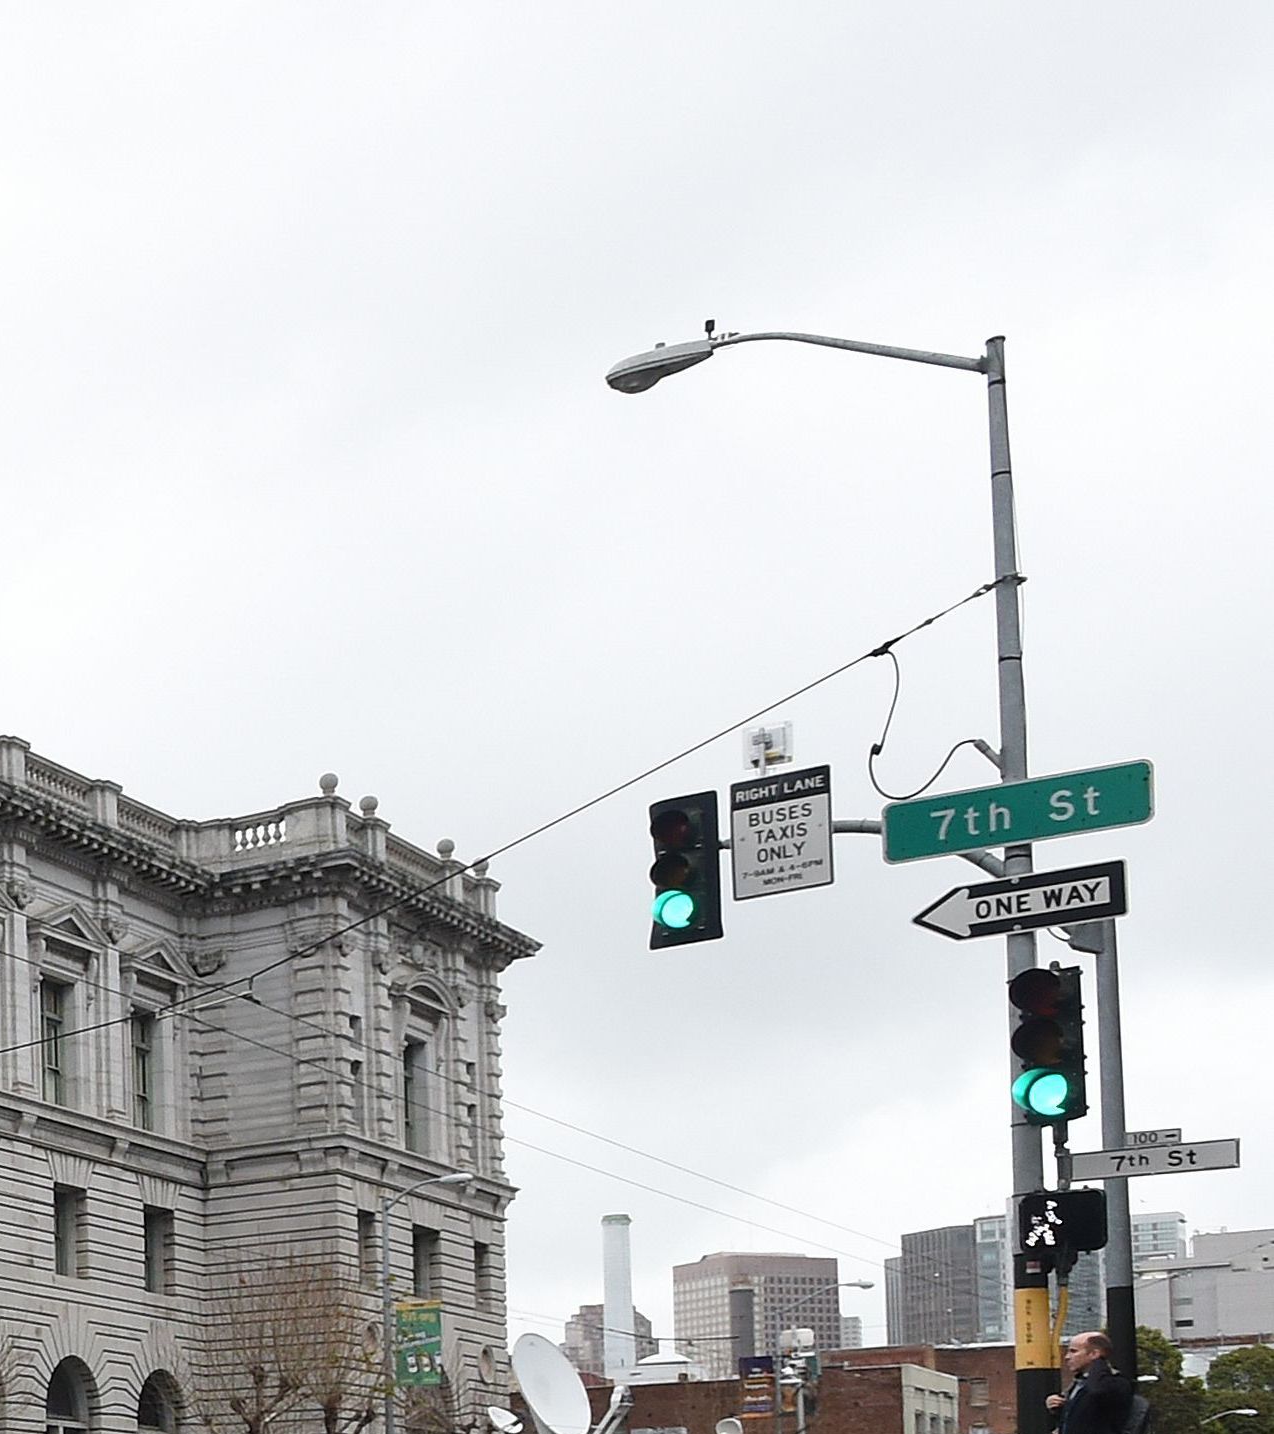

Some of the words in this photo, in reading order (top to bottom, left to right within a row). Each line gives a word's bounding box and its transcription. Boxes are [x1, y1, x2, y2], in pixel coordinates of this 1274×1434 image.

[735, 784, 777, 802] RIGHT
[783, 775, 825, 793] LANE
[748, 803, 812, 827] BUSES
[930, 802, 1011, 840] 7th
[1049, 786, 1100, 821] St
[754, 822, 807, 844] TAXIS
[757, 841, 806, 863] ONLY
[975, 893, 1031, 919] ONE
[1042, 881, 1101, 909] WAY
[1133, 1132, 1158, 1144] 100
[1110, 1154, 1150, 1172] 7th
[1167, 1149, 1197, 1167] St
